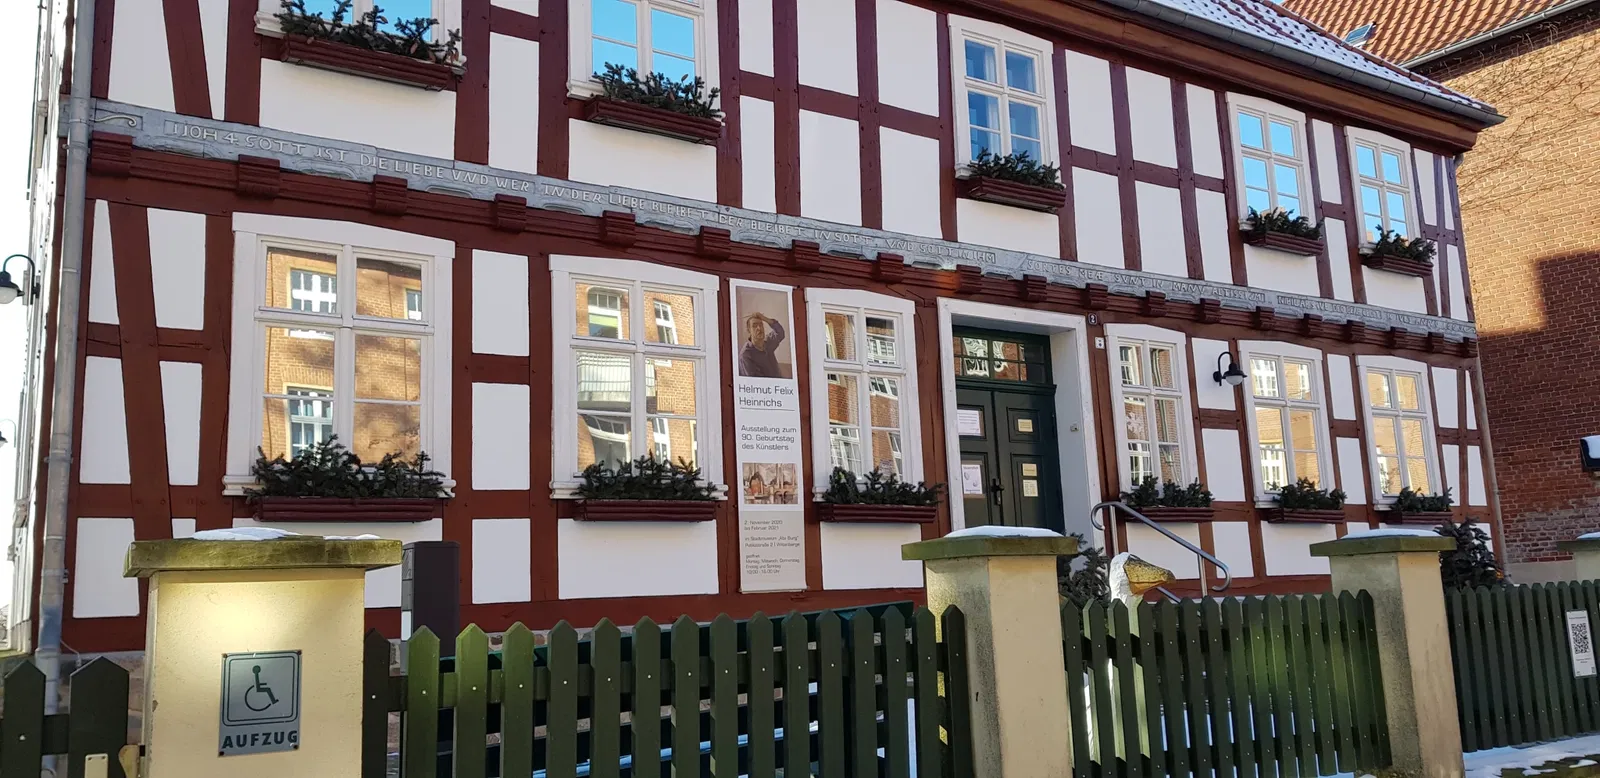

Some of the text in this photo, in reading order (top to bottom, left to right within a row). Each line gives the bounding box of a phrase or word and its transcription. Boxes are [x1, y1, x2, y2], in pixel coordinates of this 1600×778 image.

[316, 145, 349, 162] IST
[360, 153, 388, 170] DIE
[394, 160, 445, 178] LIEBE
[452, 169, 489, 185] VND
[495, 176, 530, 192] WER
[544, 184, 566, 197] IN
[571, 189, 602, 204] DER
[608, 193, 646, 210] LIEBE
[652, 201, 709, 219] BLEIBET
[718, 214, 744, 227] DER
[751, 220, 805, 236] BLEIBET
[815, 229, 832, 240] IN
[738, 384, 794, 396] Helmut Felix
[739, 396, 783, 407] Heinrichs
[741, 424, 780, 434] Ausstellung
[741, 433, 795, 444] 90. Geburtstag
[755, 443, 789, 451] Künstlers
[221, 730, 298, 749] AUFZUG
